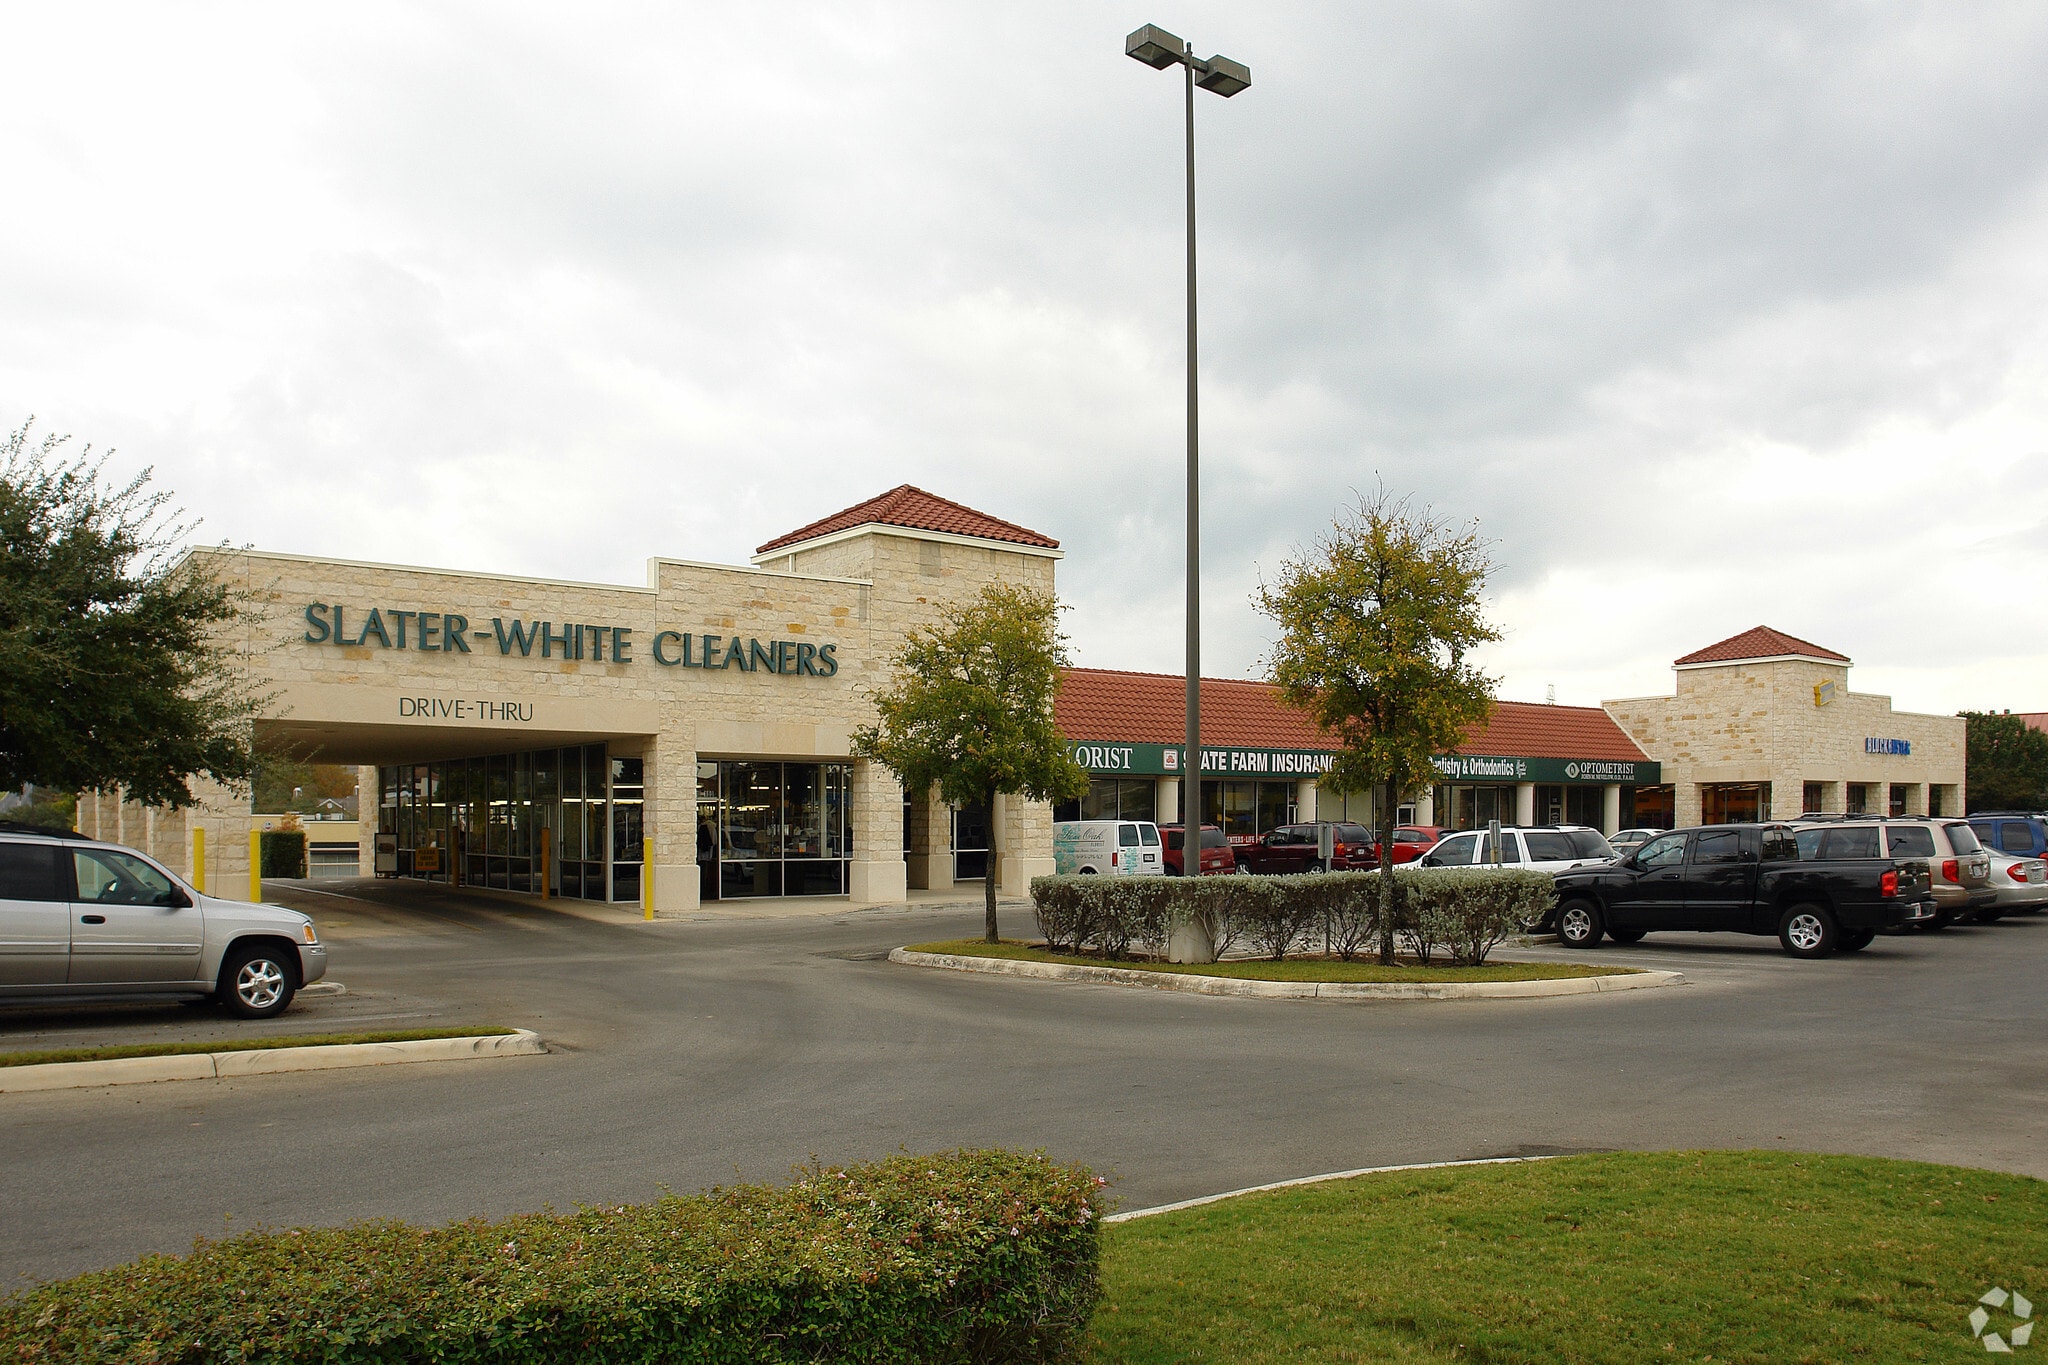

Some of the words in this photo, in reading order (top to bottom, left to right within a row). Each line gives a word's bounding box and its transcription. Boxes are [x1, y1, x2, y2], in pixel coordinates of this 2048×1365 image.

[304, 602, 632, 664] SLATER-WHITE
[653, 630, 839, 677] CLEANERS
[399, 697, 533, 722] DRIVE-THRU
[1064, 745, 1133, 769] ORIST
[1183, 750, 1227, 770] ATE
[1231, 752, 1268, 772] FARM
[1462, 758, 1469, 775] &
[1469, 757, 1514, 776] Orthodontics
[1580, 762, 1635, 774] OPTOMETRIST
